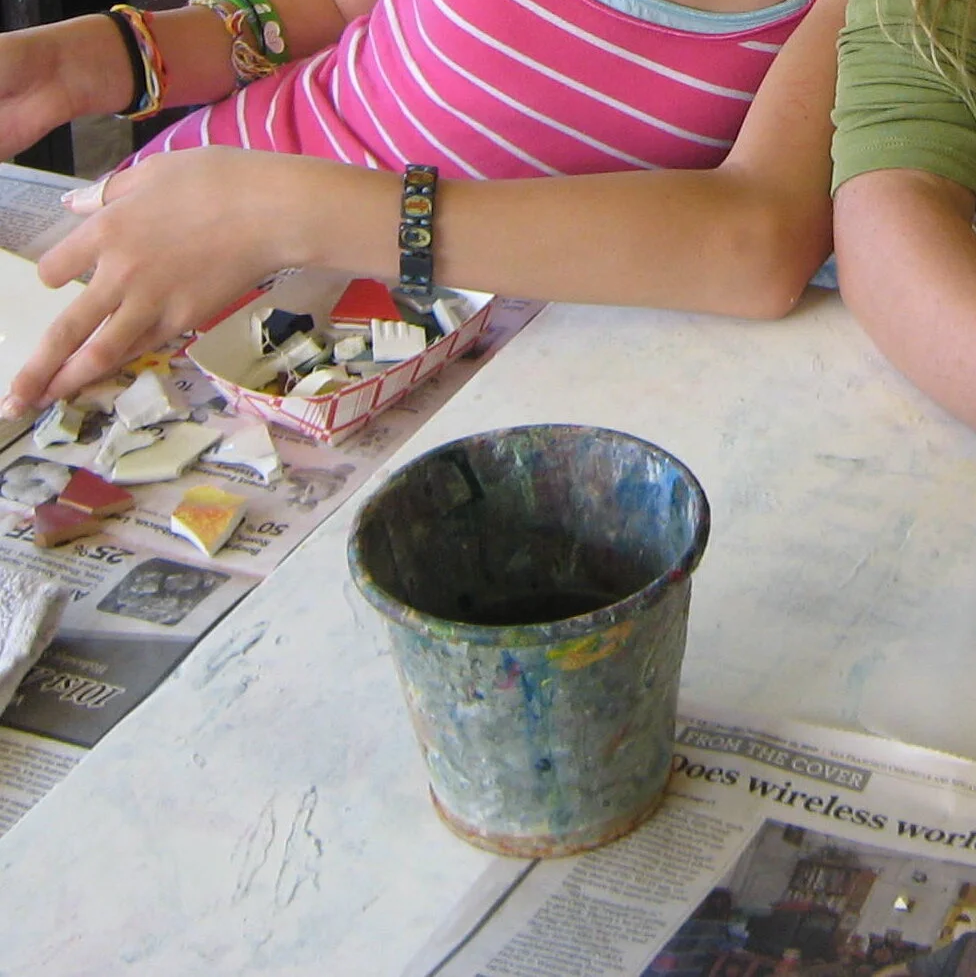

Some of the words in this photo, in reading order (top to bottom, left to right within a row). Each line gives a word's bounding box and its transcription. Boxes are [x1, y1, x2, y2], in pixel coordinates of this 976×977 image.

[684, 730, 742, 752] FROM
[748, 744, 789, 766] THE
[792, 757, 863, 789] COVER
[748, 775, 889, 831] wireless
